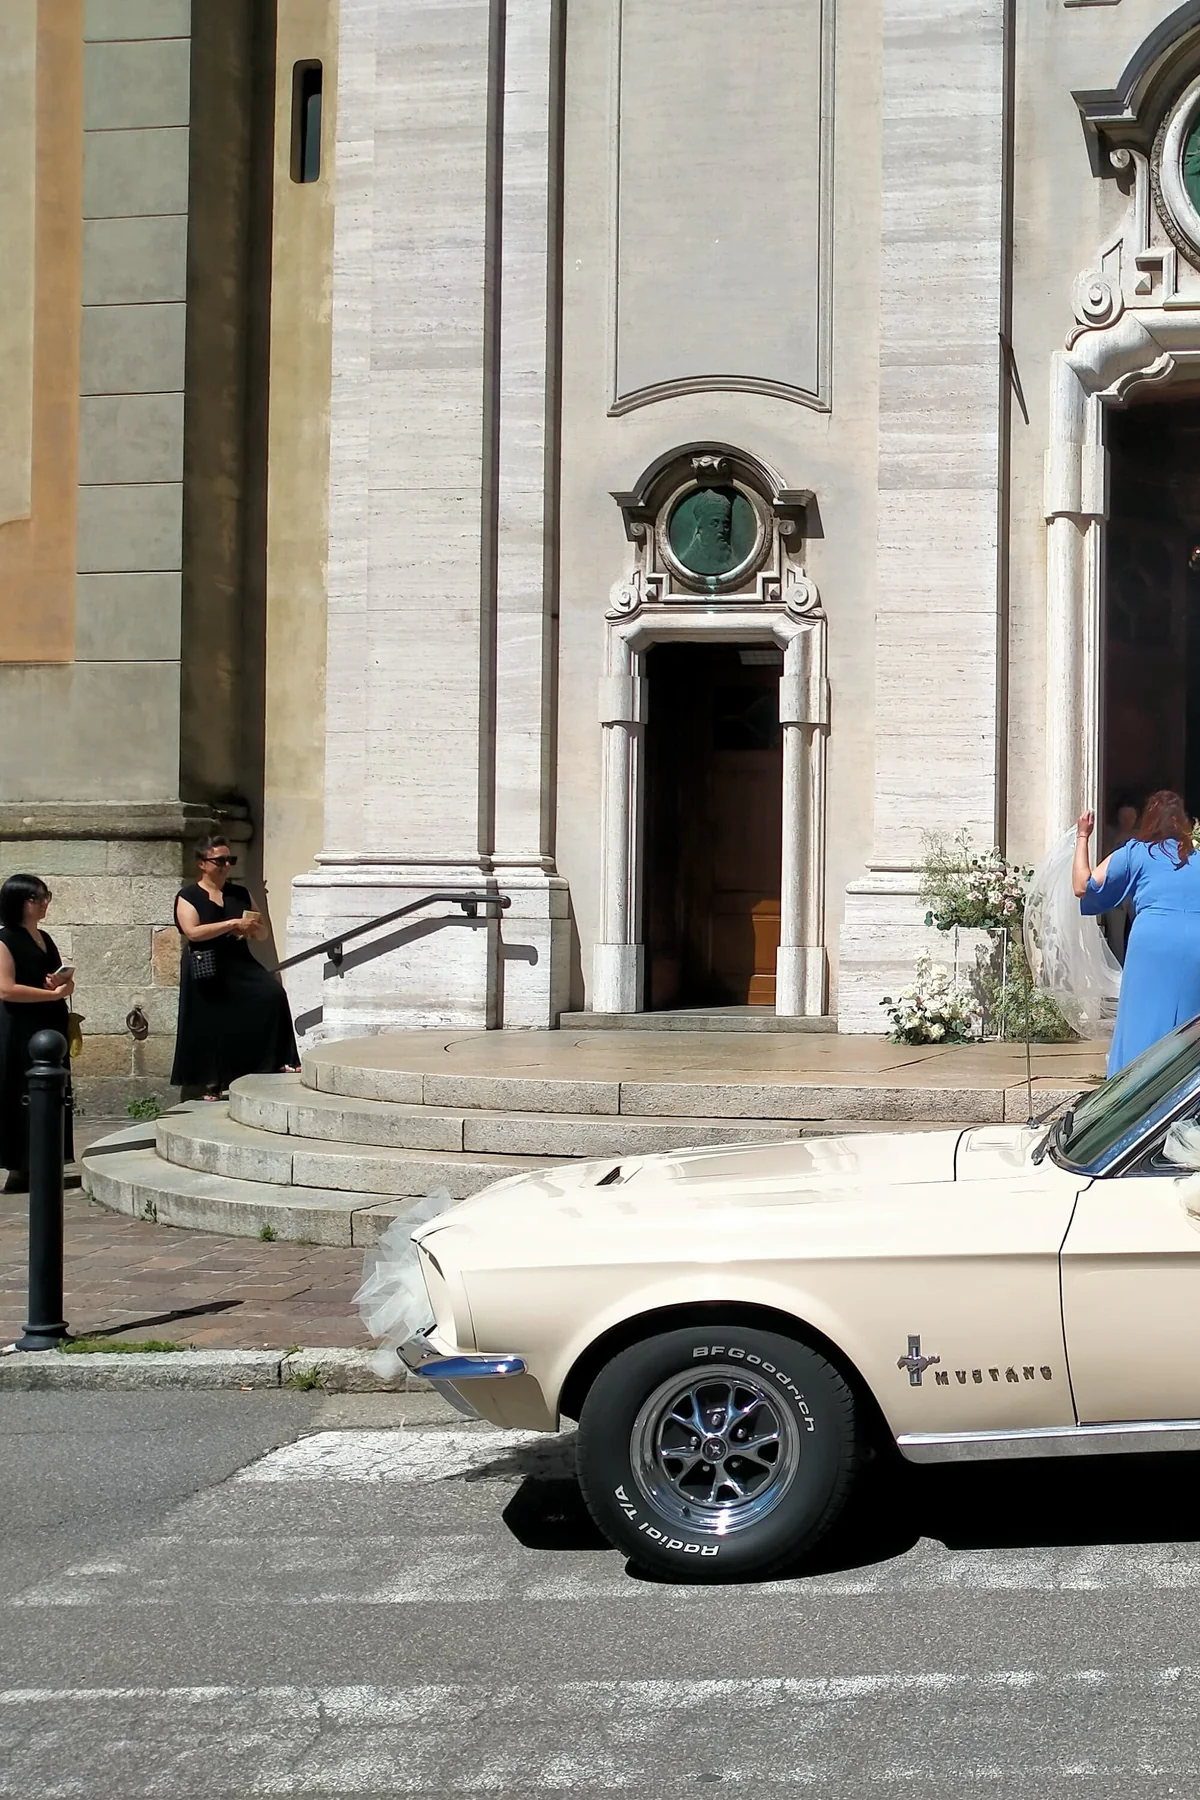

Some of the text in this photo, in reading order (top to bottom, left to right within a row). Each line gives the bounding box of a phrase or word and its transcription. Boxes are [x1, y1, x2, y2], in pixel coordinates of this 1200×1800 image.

[692, 1346, 815, 1432] BFGoodrich
[614, 1484, 720, 1556] Radial T/A
